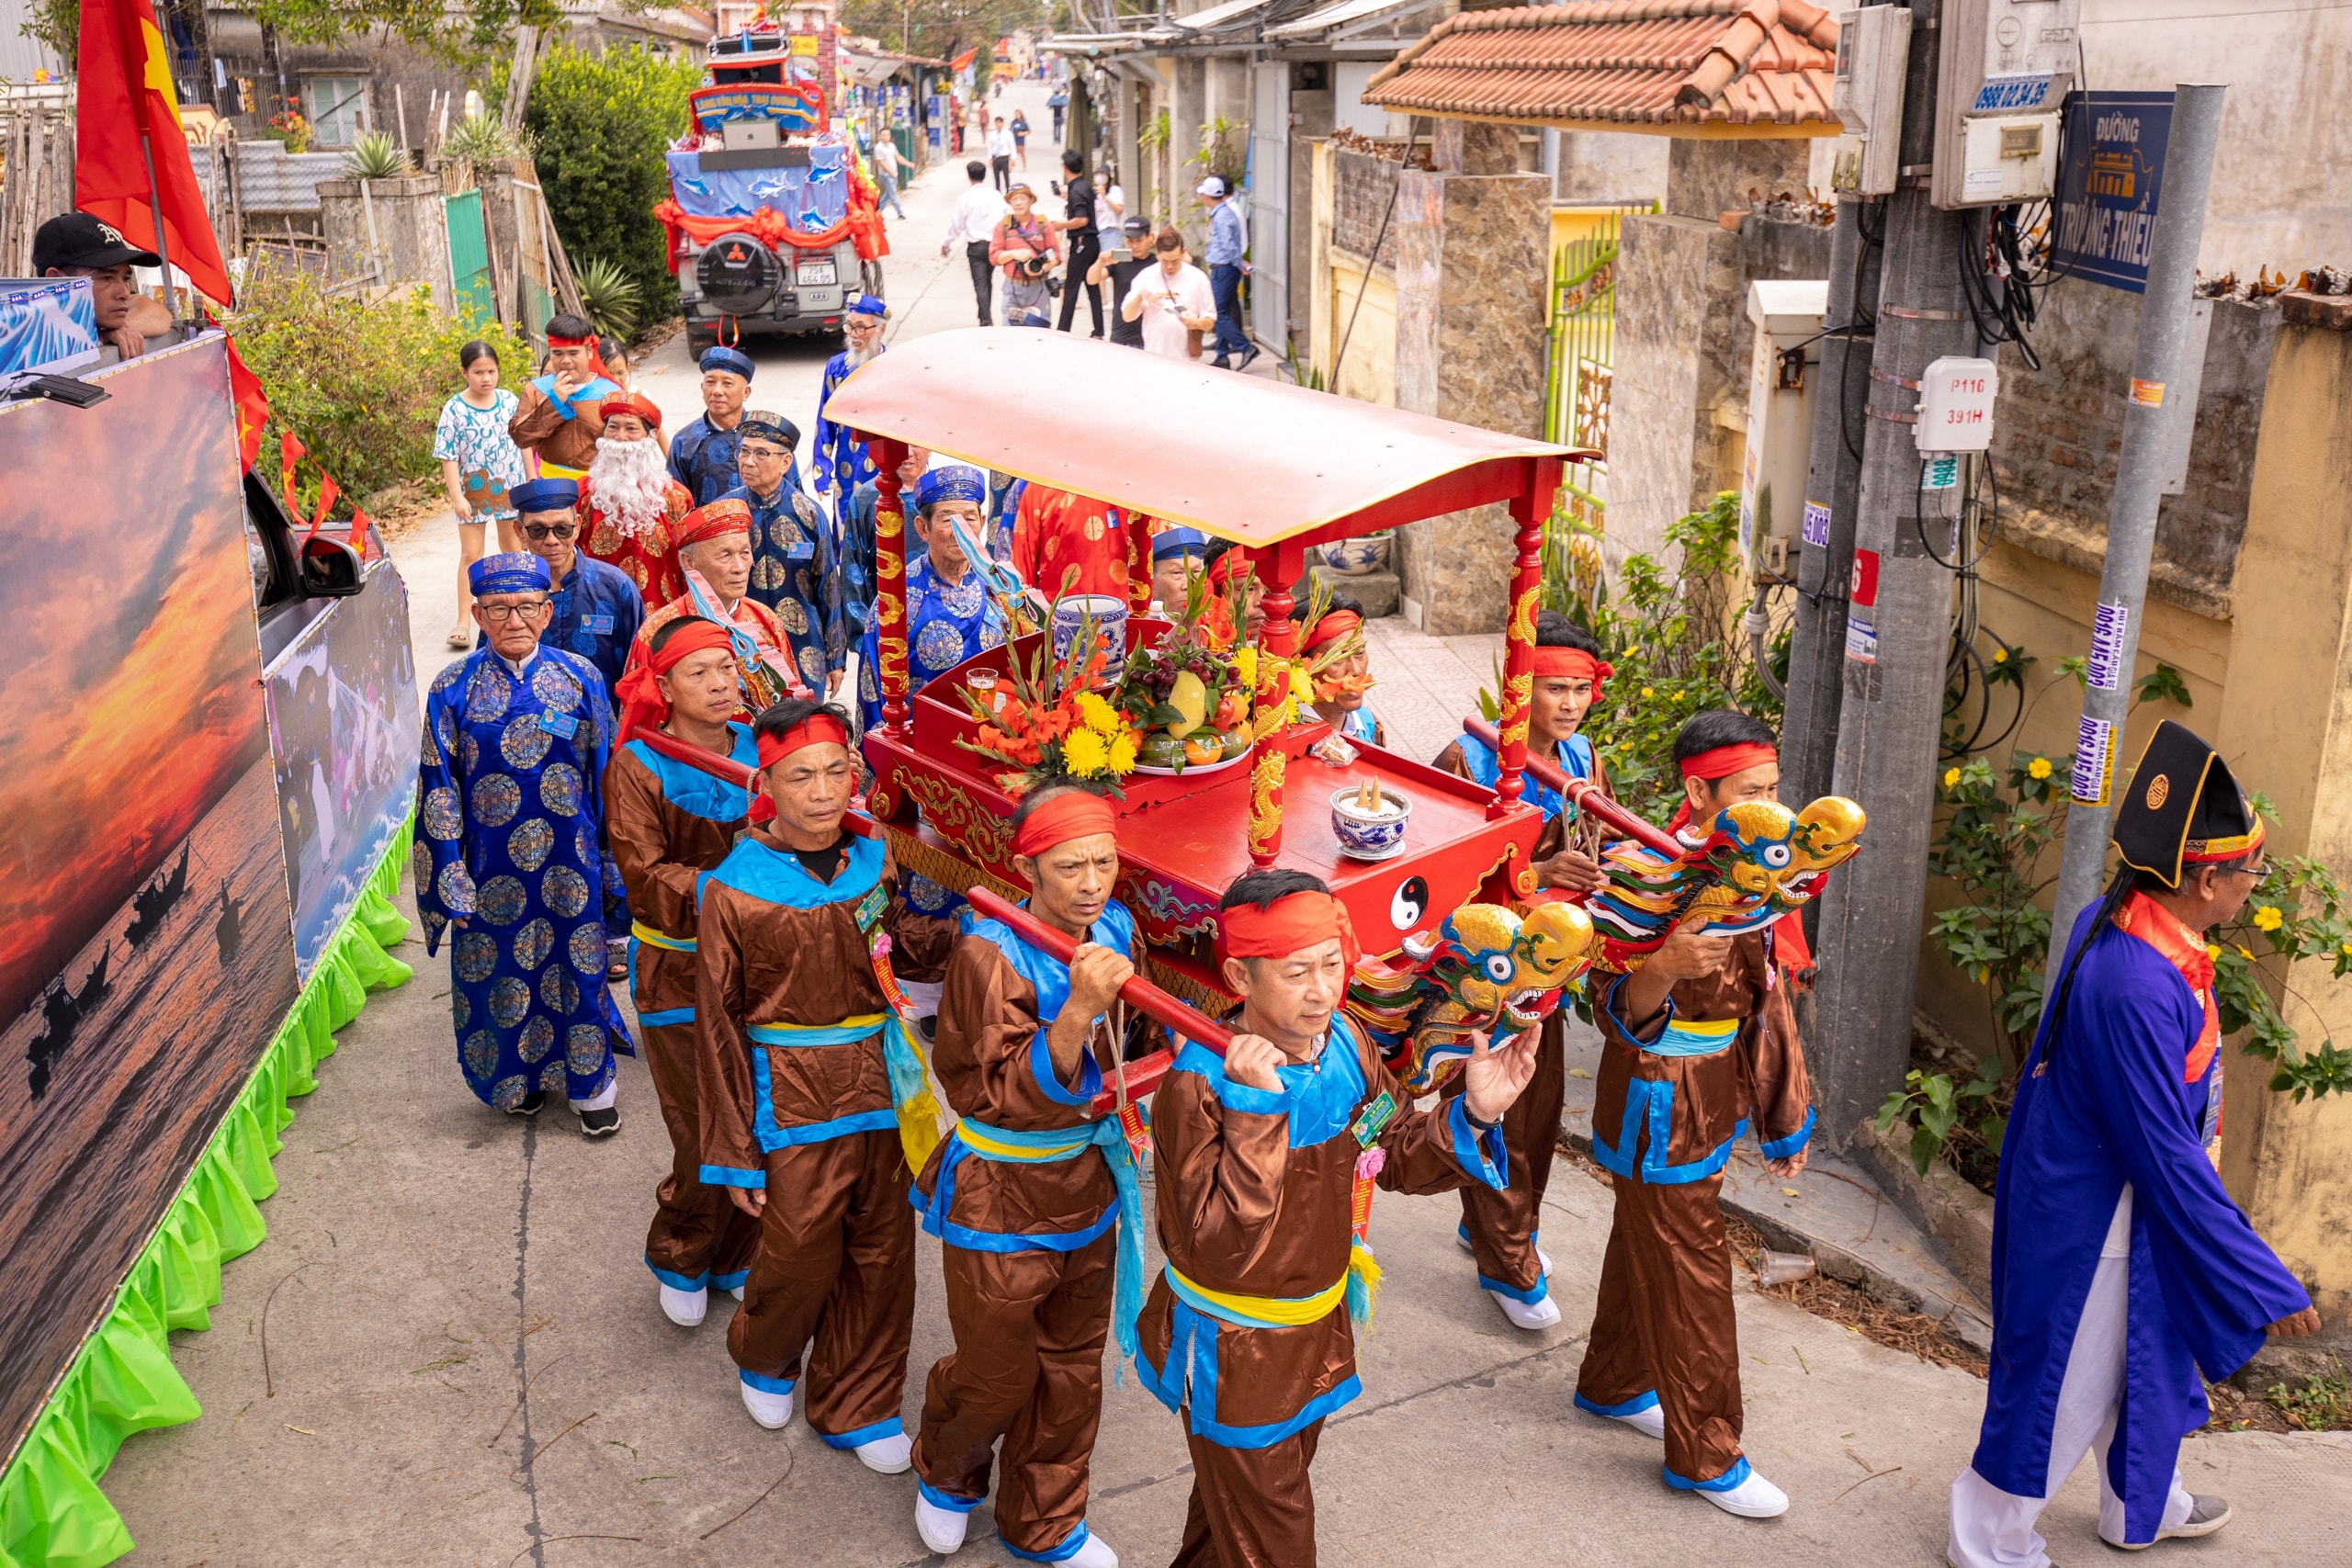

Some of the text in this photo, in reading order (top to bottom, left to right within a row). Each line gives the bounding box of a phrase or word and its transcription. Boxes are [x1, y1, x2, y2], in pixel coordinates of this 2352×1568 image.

[2096, 110, 2140, 142] ĐƯỜNG
[1951, 378, 1985, 393] P116
[1947, 410, 1984, 423] 391H
